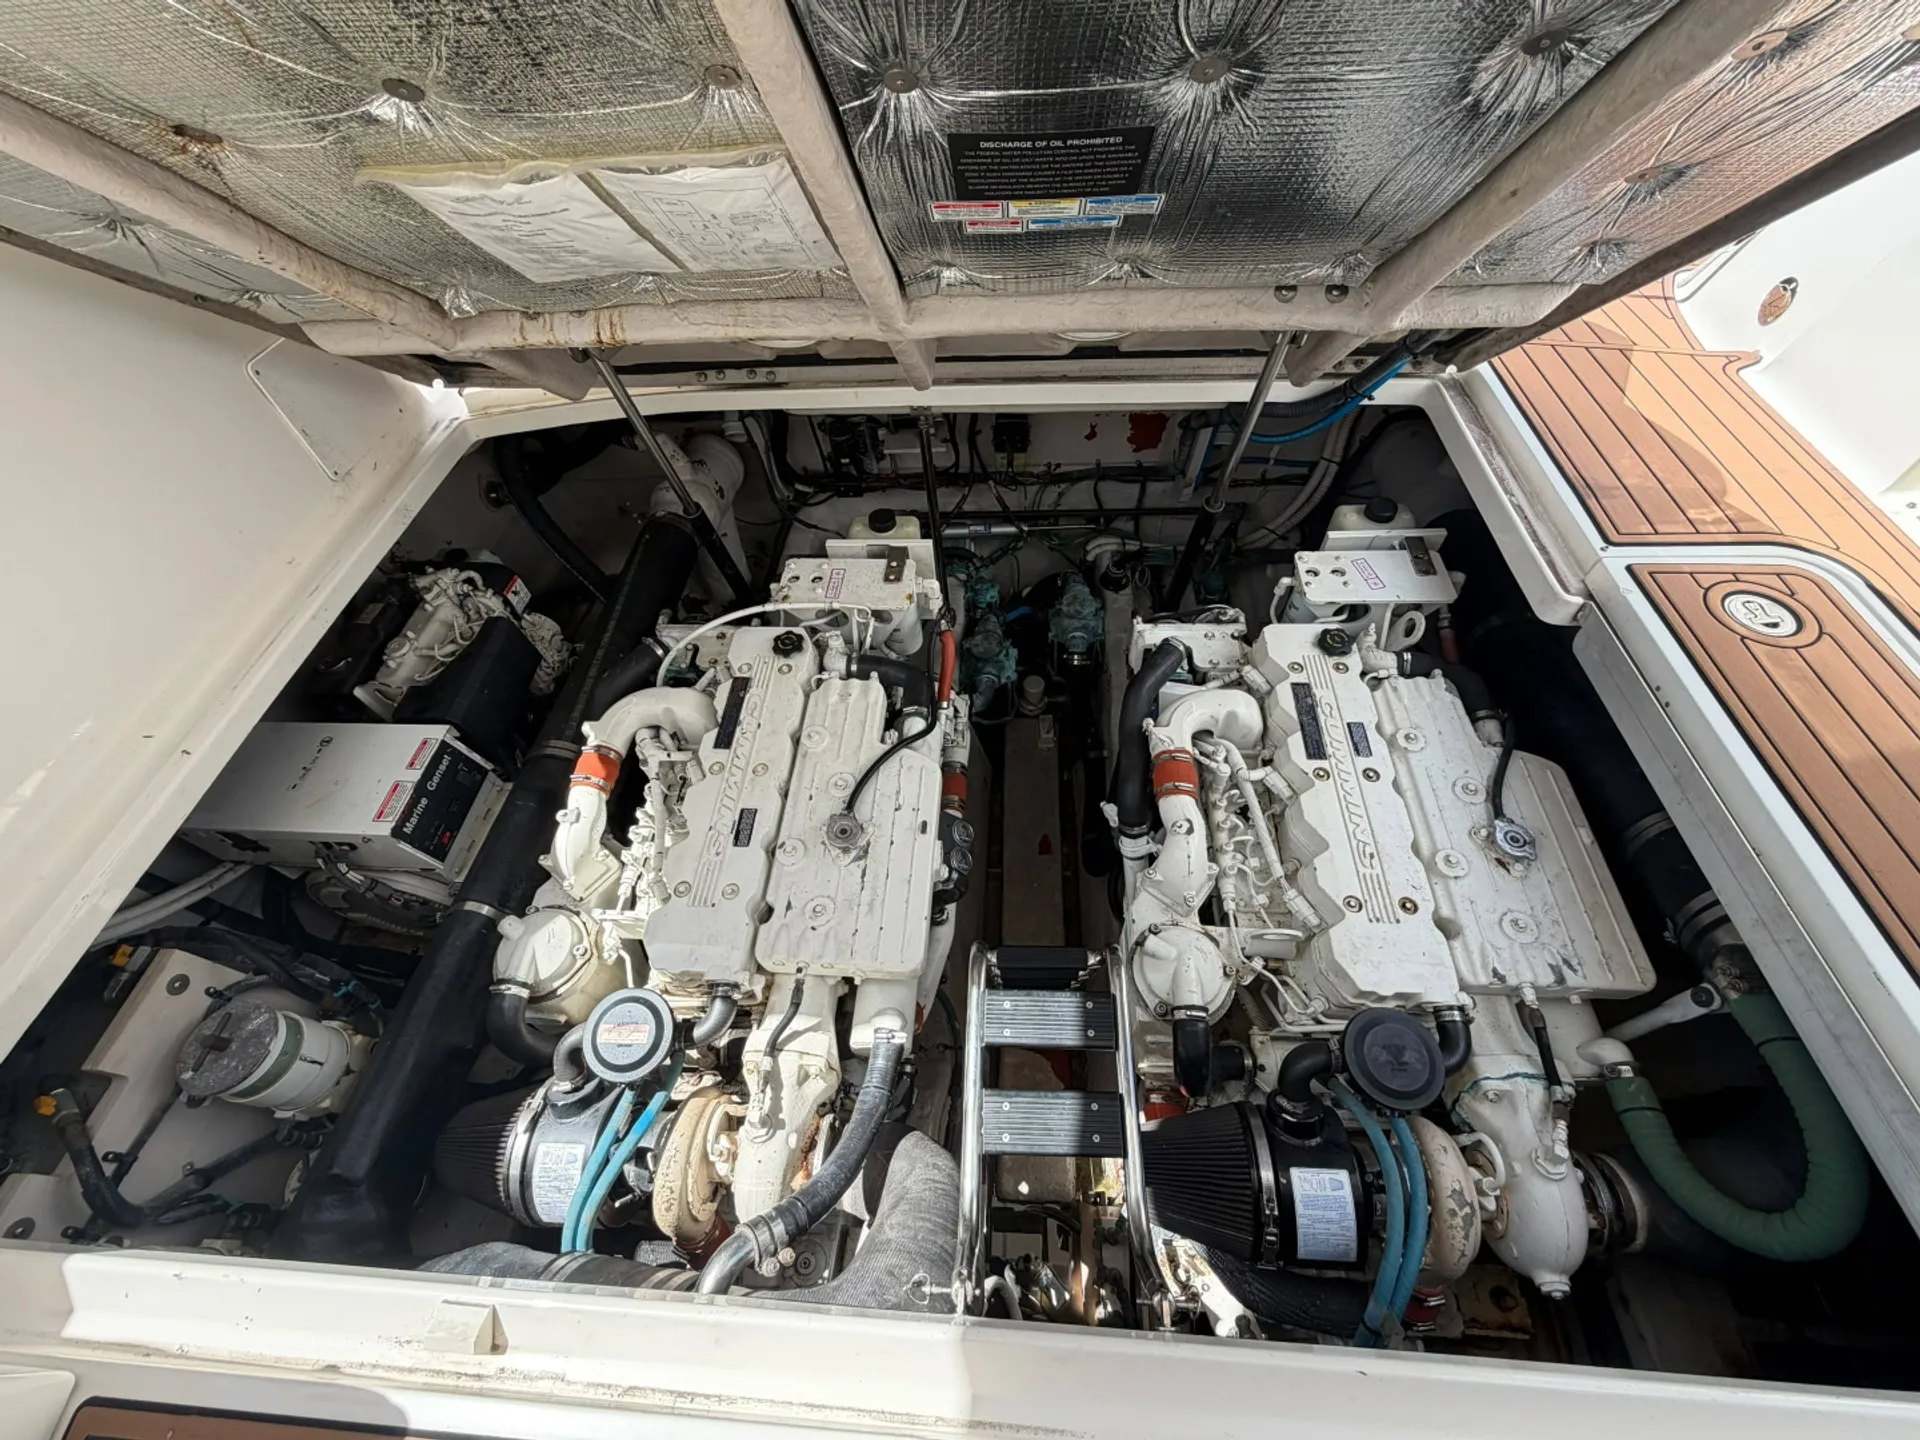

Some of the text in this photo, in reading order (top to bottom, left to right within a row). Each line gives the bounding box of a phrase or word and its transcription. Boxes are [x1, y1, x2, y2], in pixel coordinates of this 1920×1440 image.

[1034, 140, 1048, 148] OF
[1066, 136, 1123, 147] PROHIBITED
[402, 797, 429, 835] Marine
[426, 754, 452, 791] Genset
[1318, 694, 1375, 870] CUMMINS
